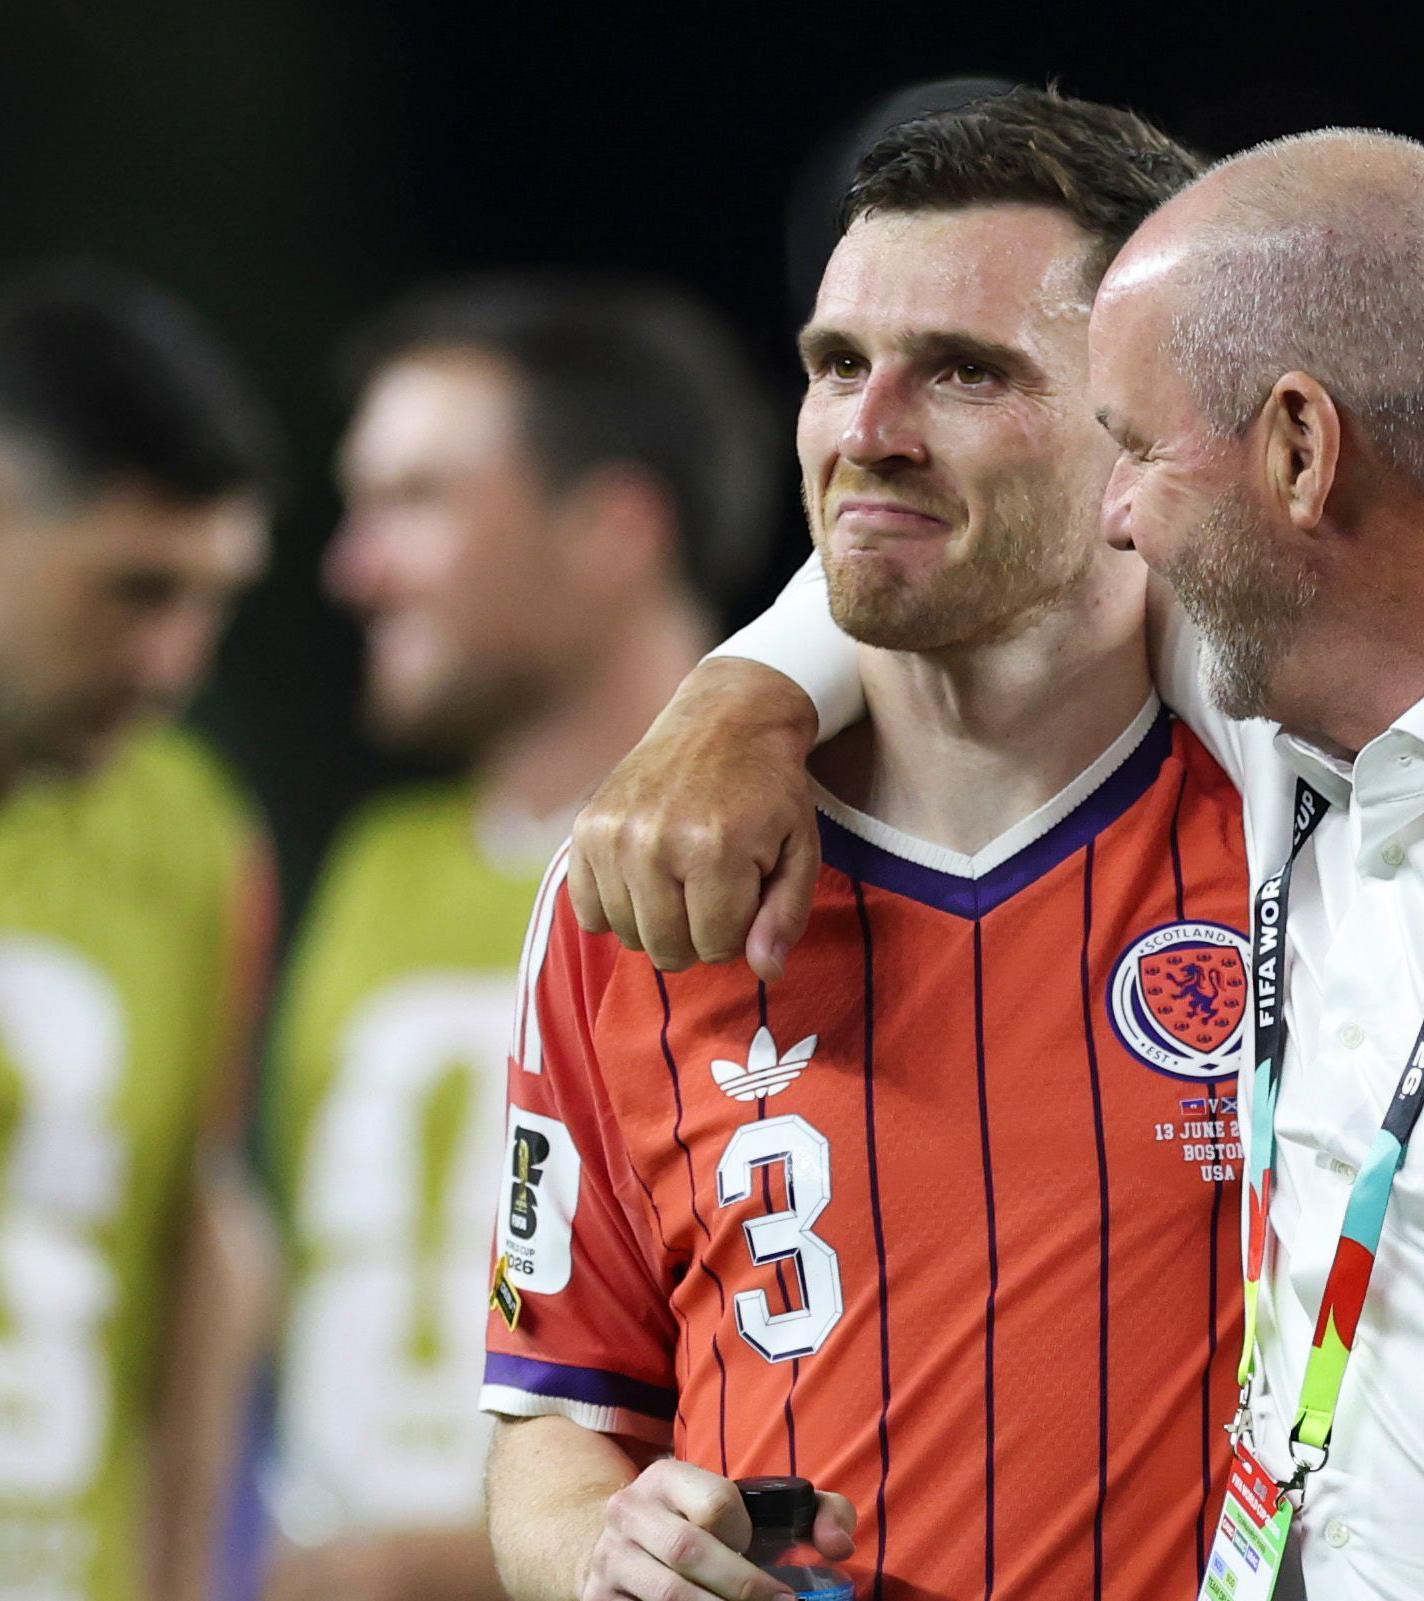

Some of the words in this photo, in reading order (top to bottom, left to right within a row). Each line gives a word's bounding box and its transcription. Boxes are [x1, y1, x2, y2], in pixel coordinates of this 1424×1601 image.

[1145, 928, 1226, 950] SCOTLAND
[1258, 957, 1277, 1028] FIFA
[1146, 1045, 1171, 1064] EST
[1155, 1123, 1175, 1141] 13
[1180, 1121, 1225, 1139] JUNE
[1201, 1165, 1235, 1182] USA
[716, 1113, 843, 1363] 3
[506, 1252, 534, 1275] 026
